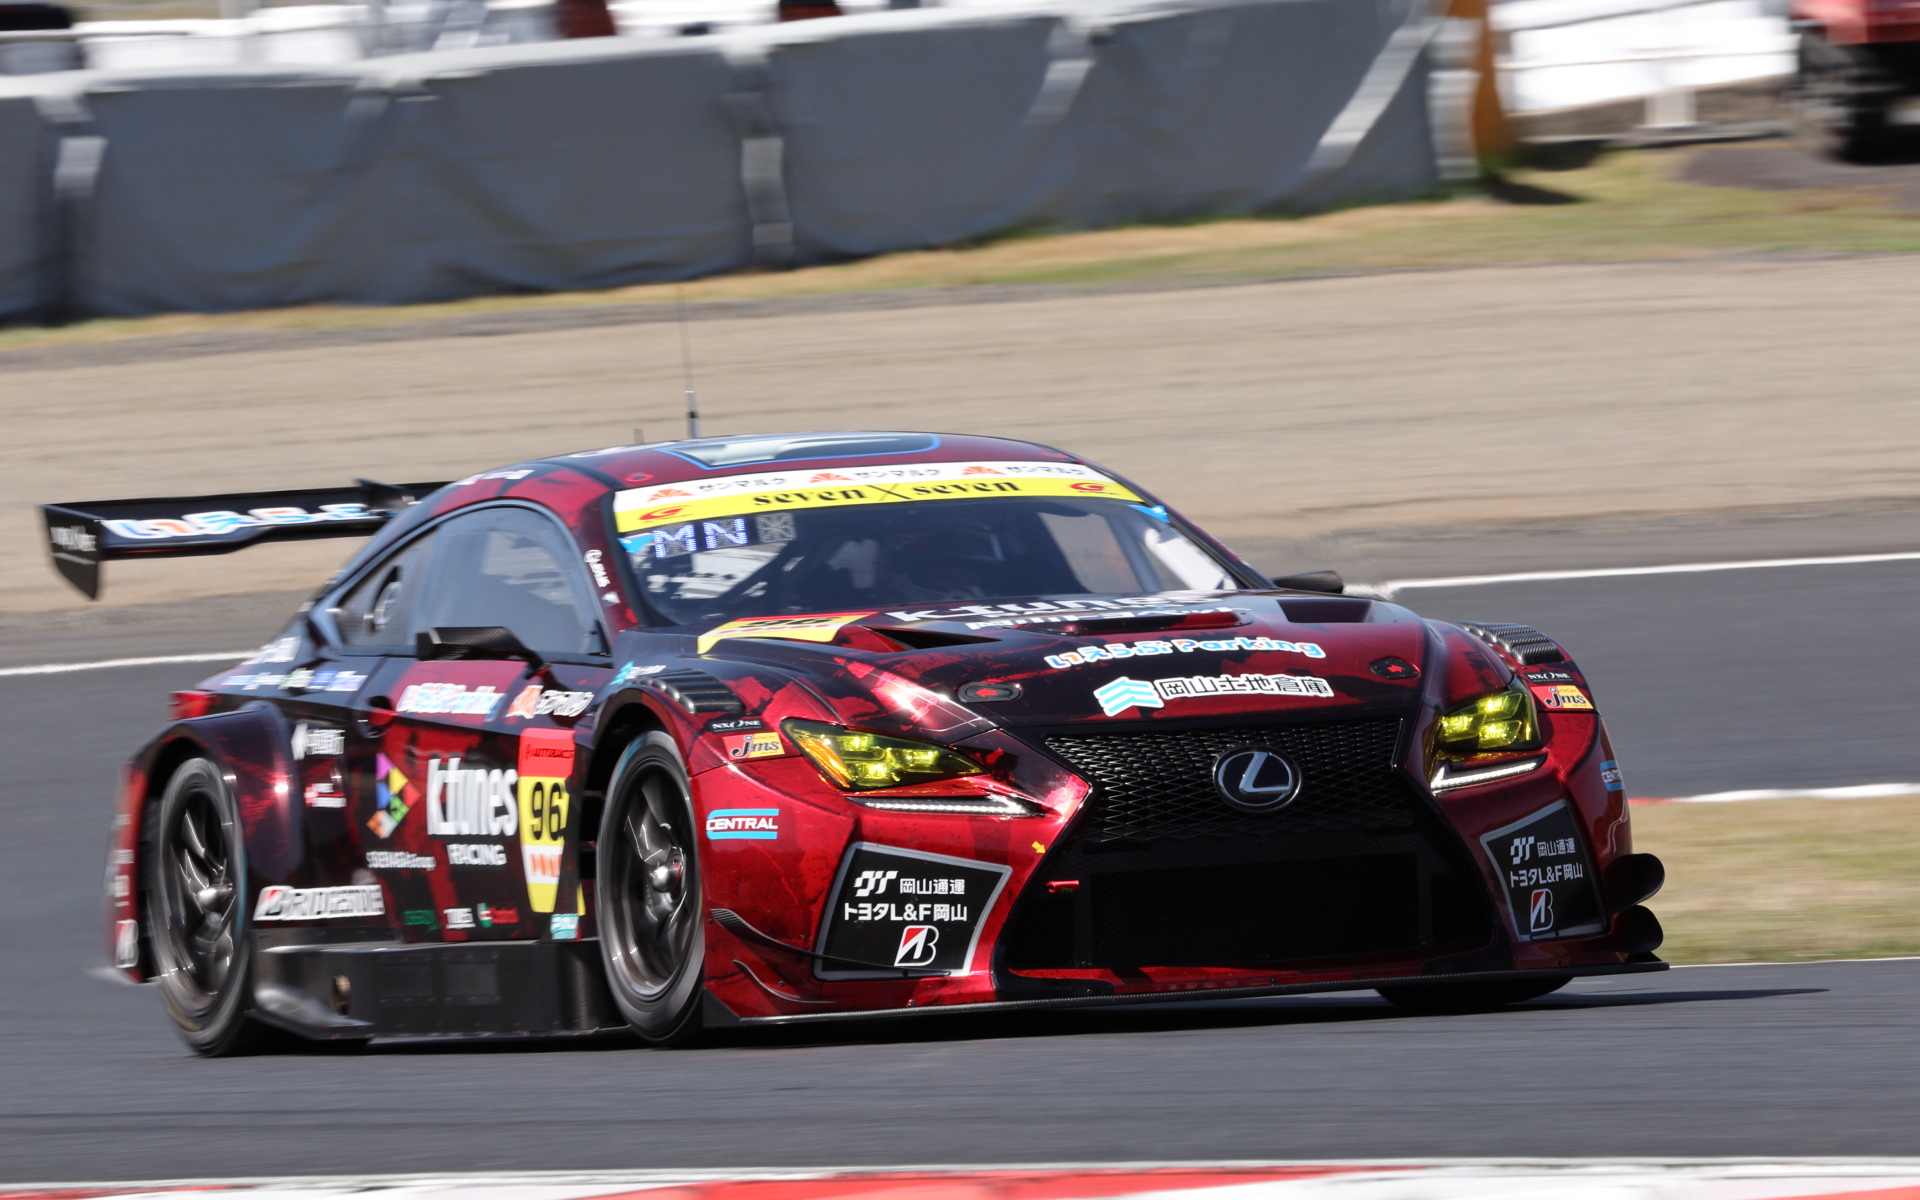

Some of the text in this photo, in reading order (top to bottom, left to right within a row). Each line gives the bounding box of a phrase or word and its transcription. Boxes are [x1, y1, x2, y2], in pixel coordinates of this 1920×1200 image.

[753, 487, 868, 506] seven
[913, 481, 1023, 496] seven
[1044, 636, 1327, 669] いえらぶ Parking
[1156, 674, 1334, 698] 岡山土地倉庫
[1545, 686, 1586, 708] jms
[731, 735, 779, 758] jms
[529, 781, 567, 841] 96
[706, 816, 779, 831] CENTRAL
[1537, 838, 1575, 857] 岡山通運
[899, 878, 965, 895] 岡山通運
[1510, 862, 1583, 888] トヨタL&F岡山
[844, 903, 968, 922] トヨタL&F岡山
